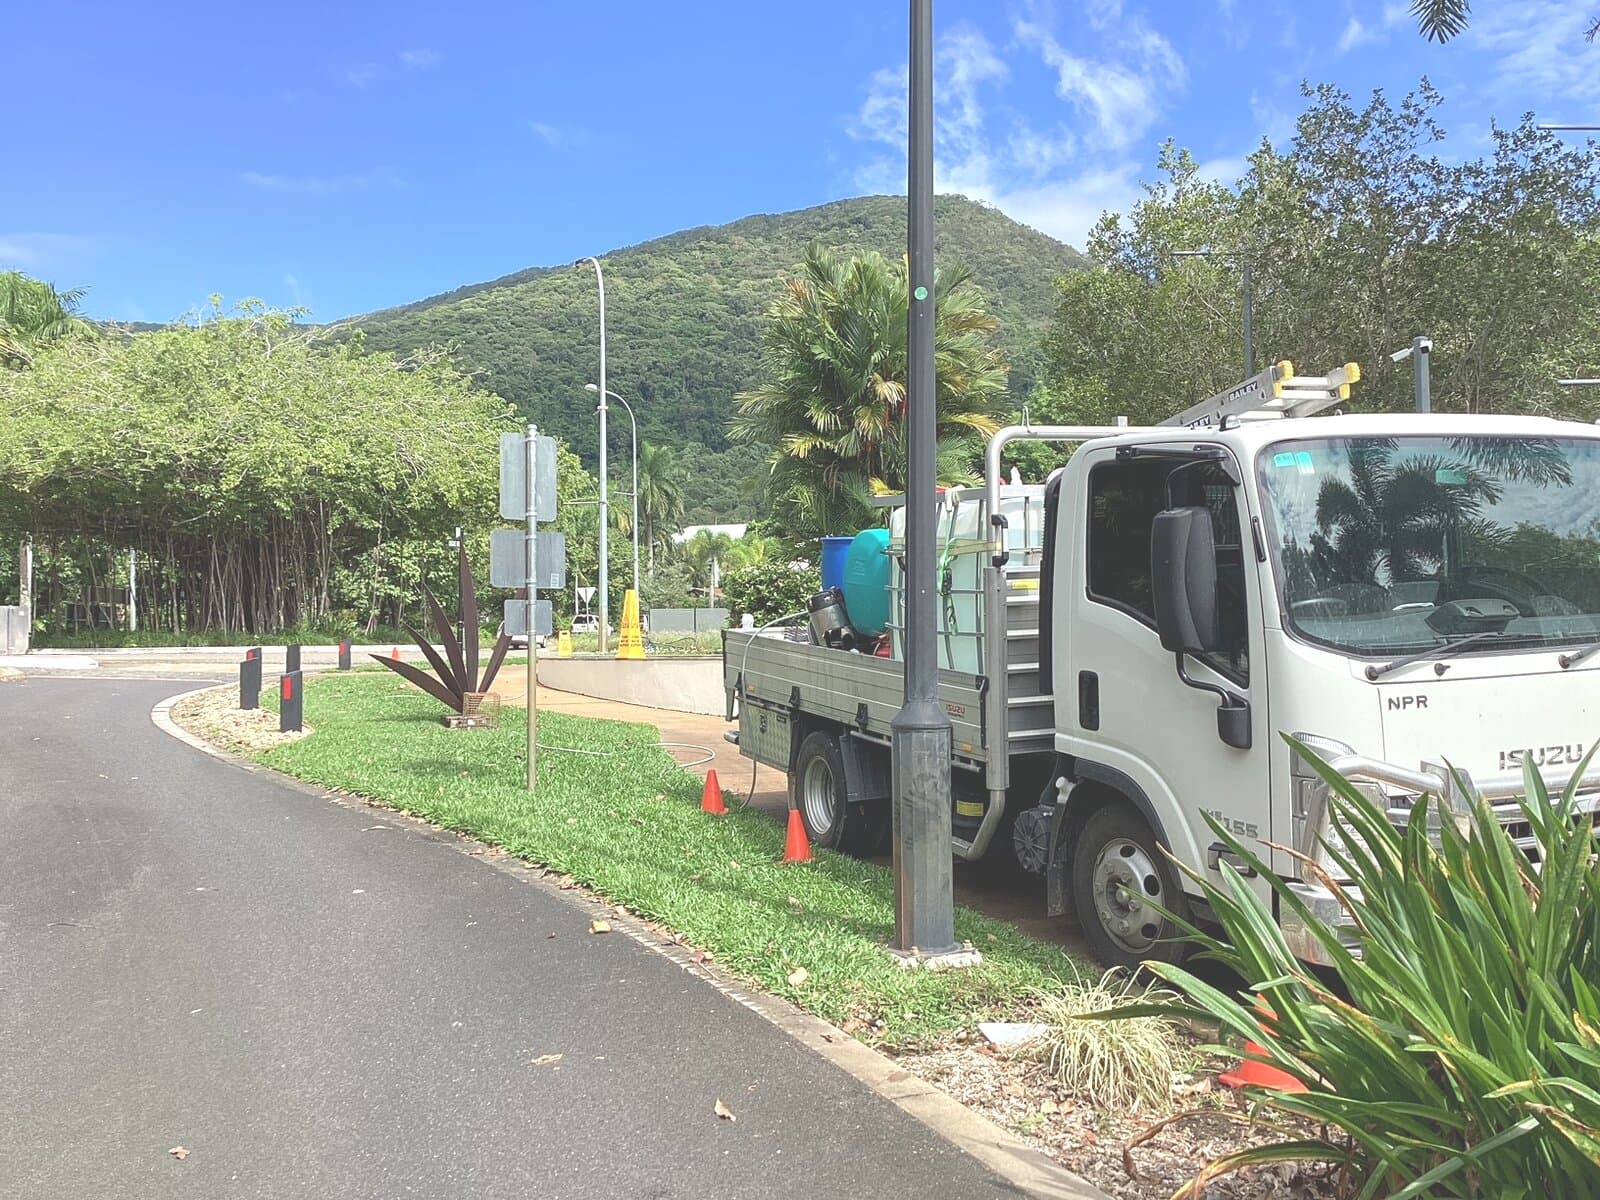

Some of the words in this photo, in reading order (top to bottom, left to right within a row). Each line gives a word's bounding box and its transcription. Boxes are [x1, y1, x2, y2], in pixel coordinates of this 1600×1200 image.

[1229, 382, 1257, 401] BAILEY
[1387, 694, 1429, 711] NPR
[1499, 743, 1583, 771] ISUZU
